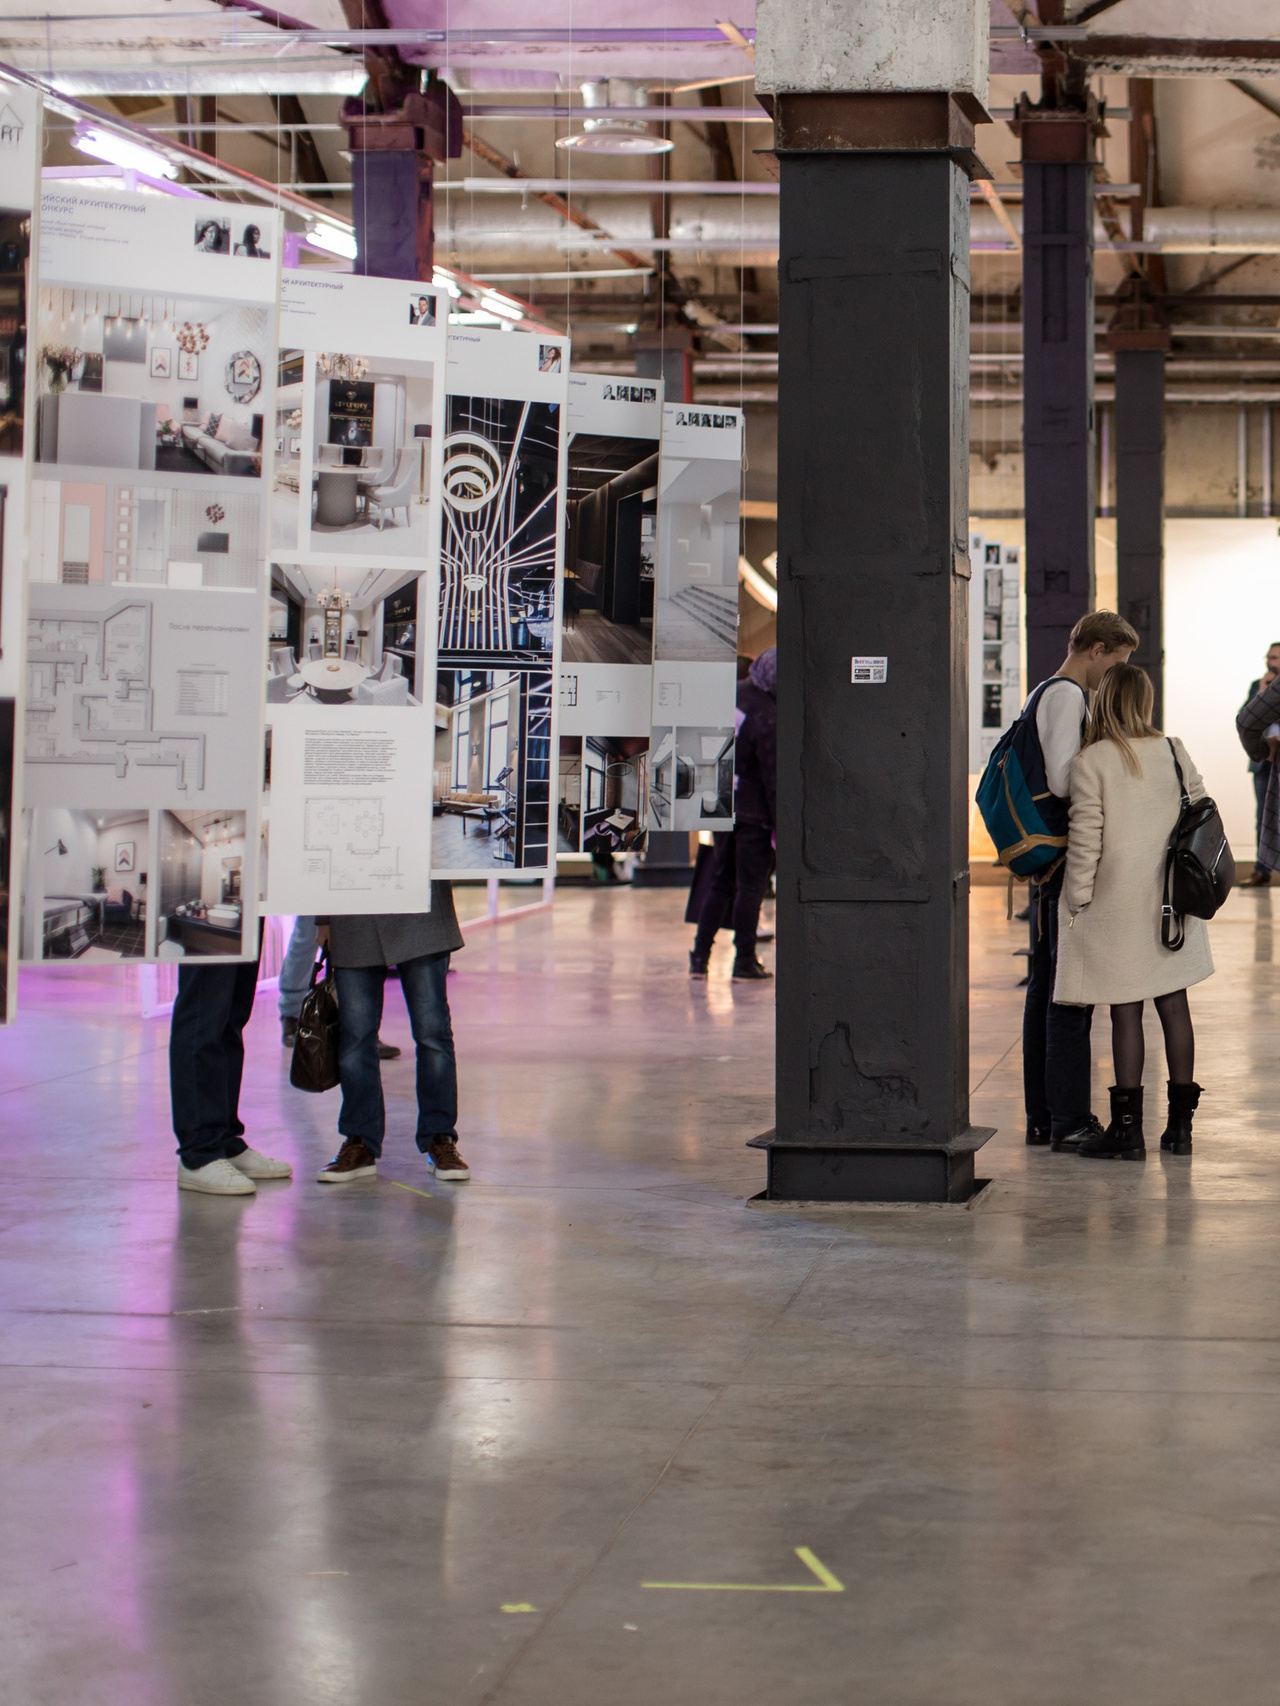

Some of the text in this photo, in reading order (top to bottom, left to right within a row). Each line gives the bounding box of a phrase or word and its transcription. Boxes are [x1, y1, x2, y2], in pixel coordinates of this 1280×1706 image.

[41, 193, 146, 214] ИЙСКИЙ АРХИТЕКТУРНЫЙ
[291, 279, 344, 291] АРХИТЕКТУРНЫЙ
